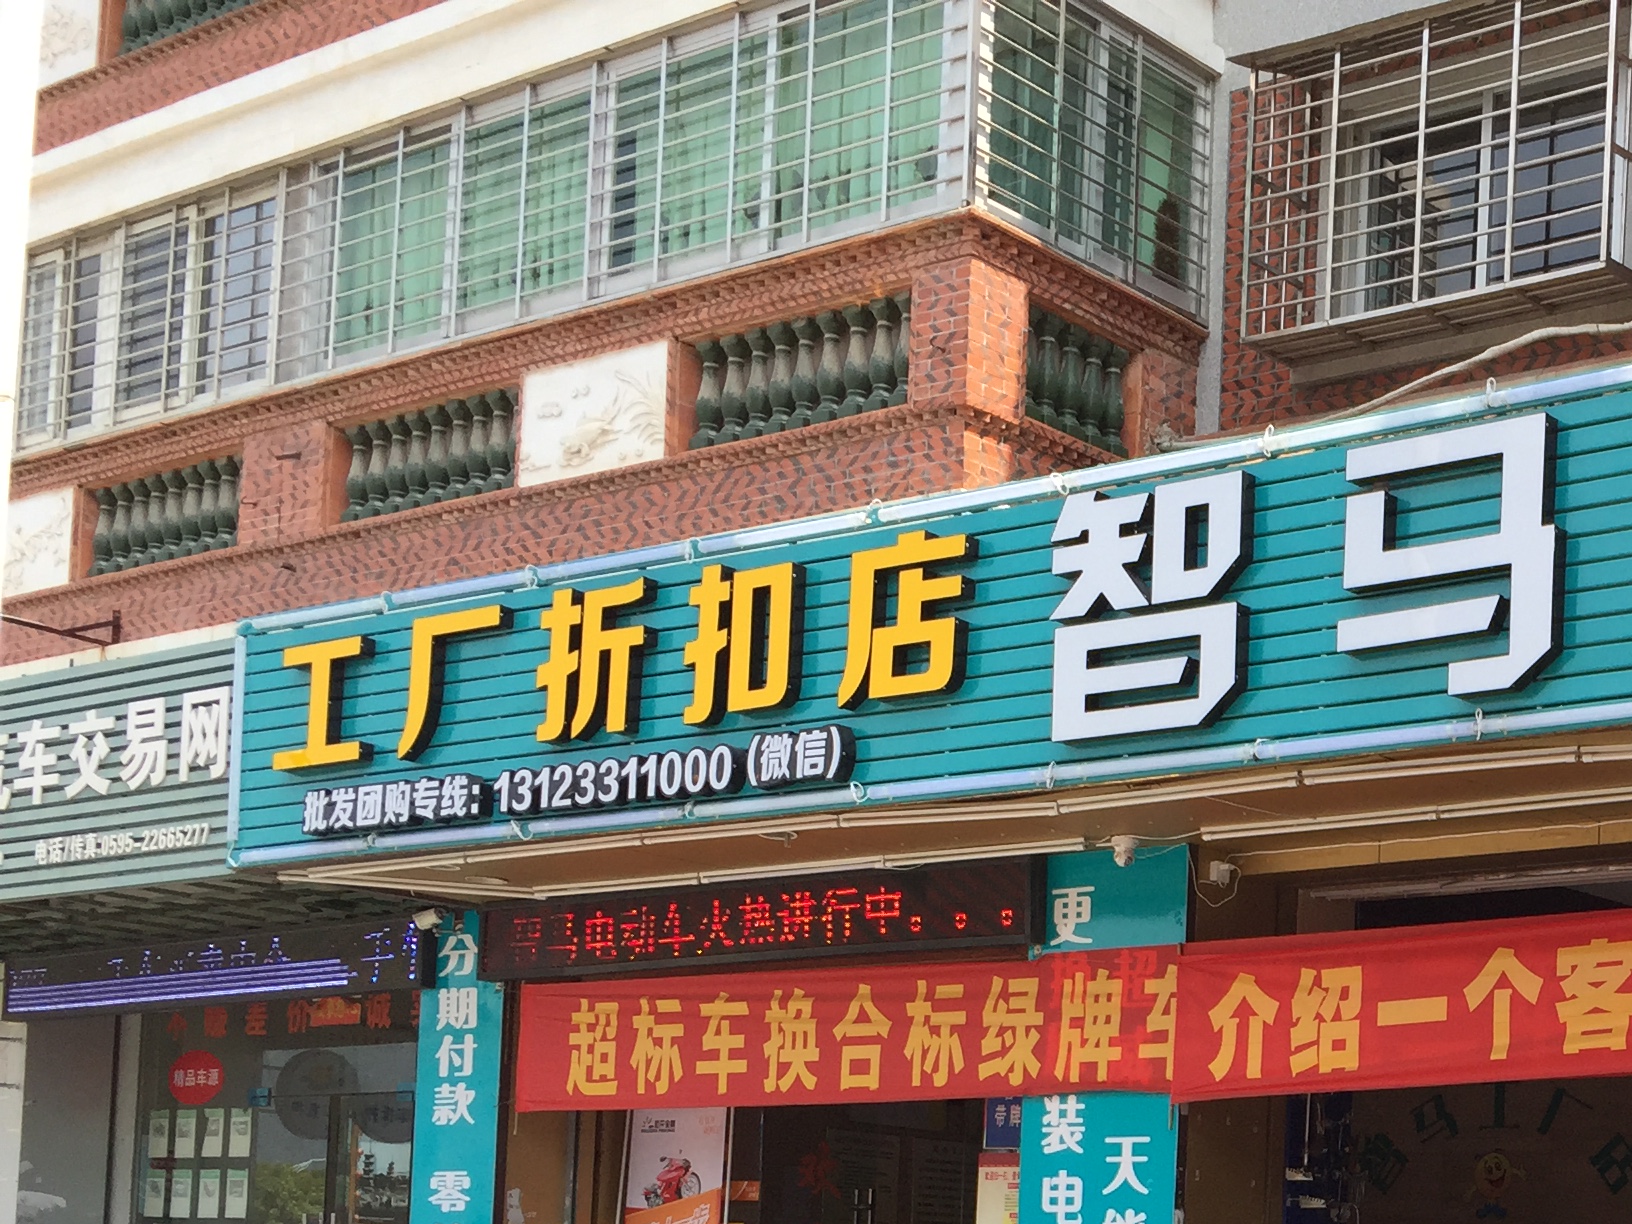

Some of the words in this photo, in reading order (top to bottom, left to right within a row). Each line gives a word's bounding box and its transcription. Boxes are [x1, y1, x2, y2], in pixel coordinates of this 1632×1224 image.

[272, 529, 976, 771] 工厂折扣店
[172, 1068, 220, 1088] 精品车源
[431, 933, 479, 1127] 分期付款
